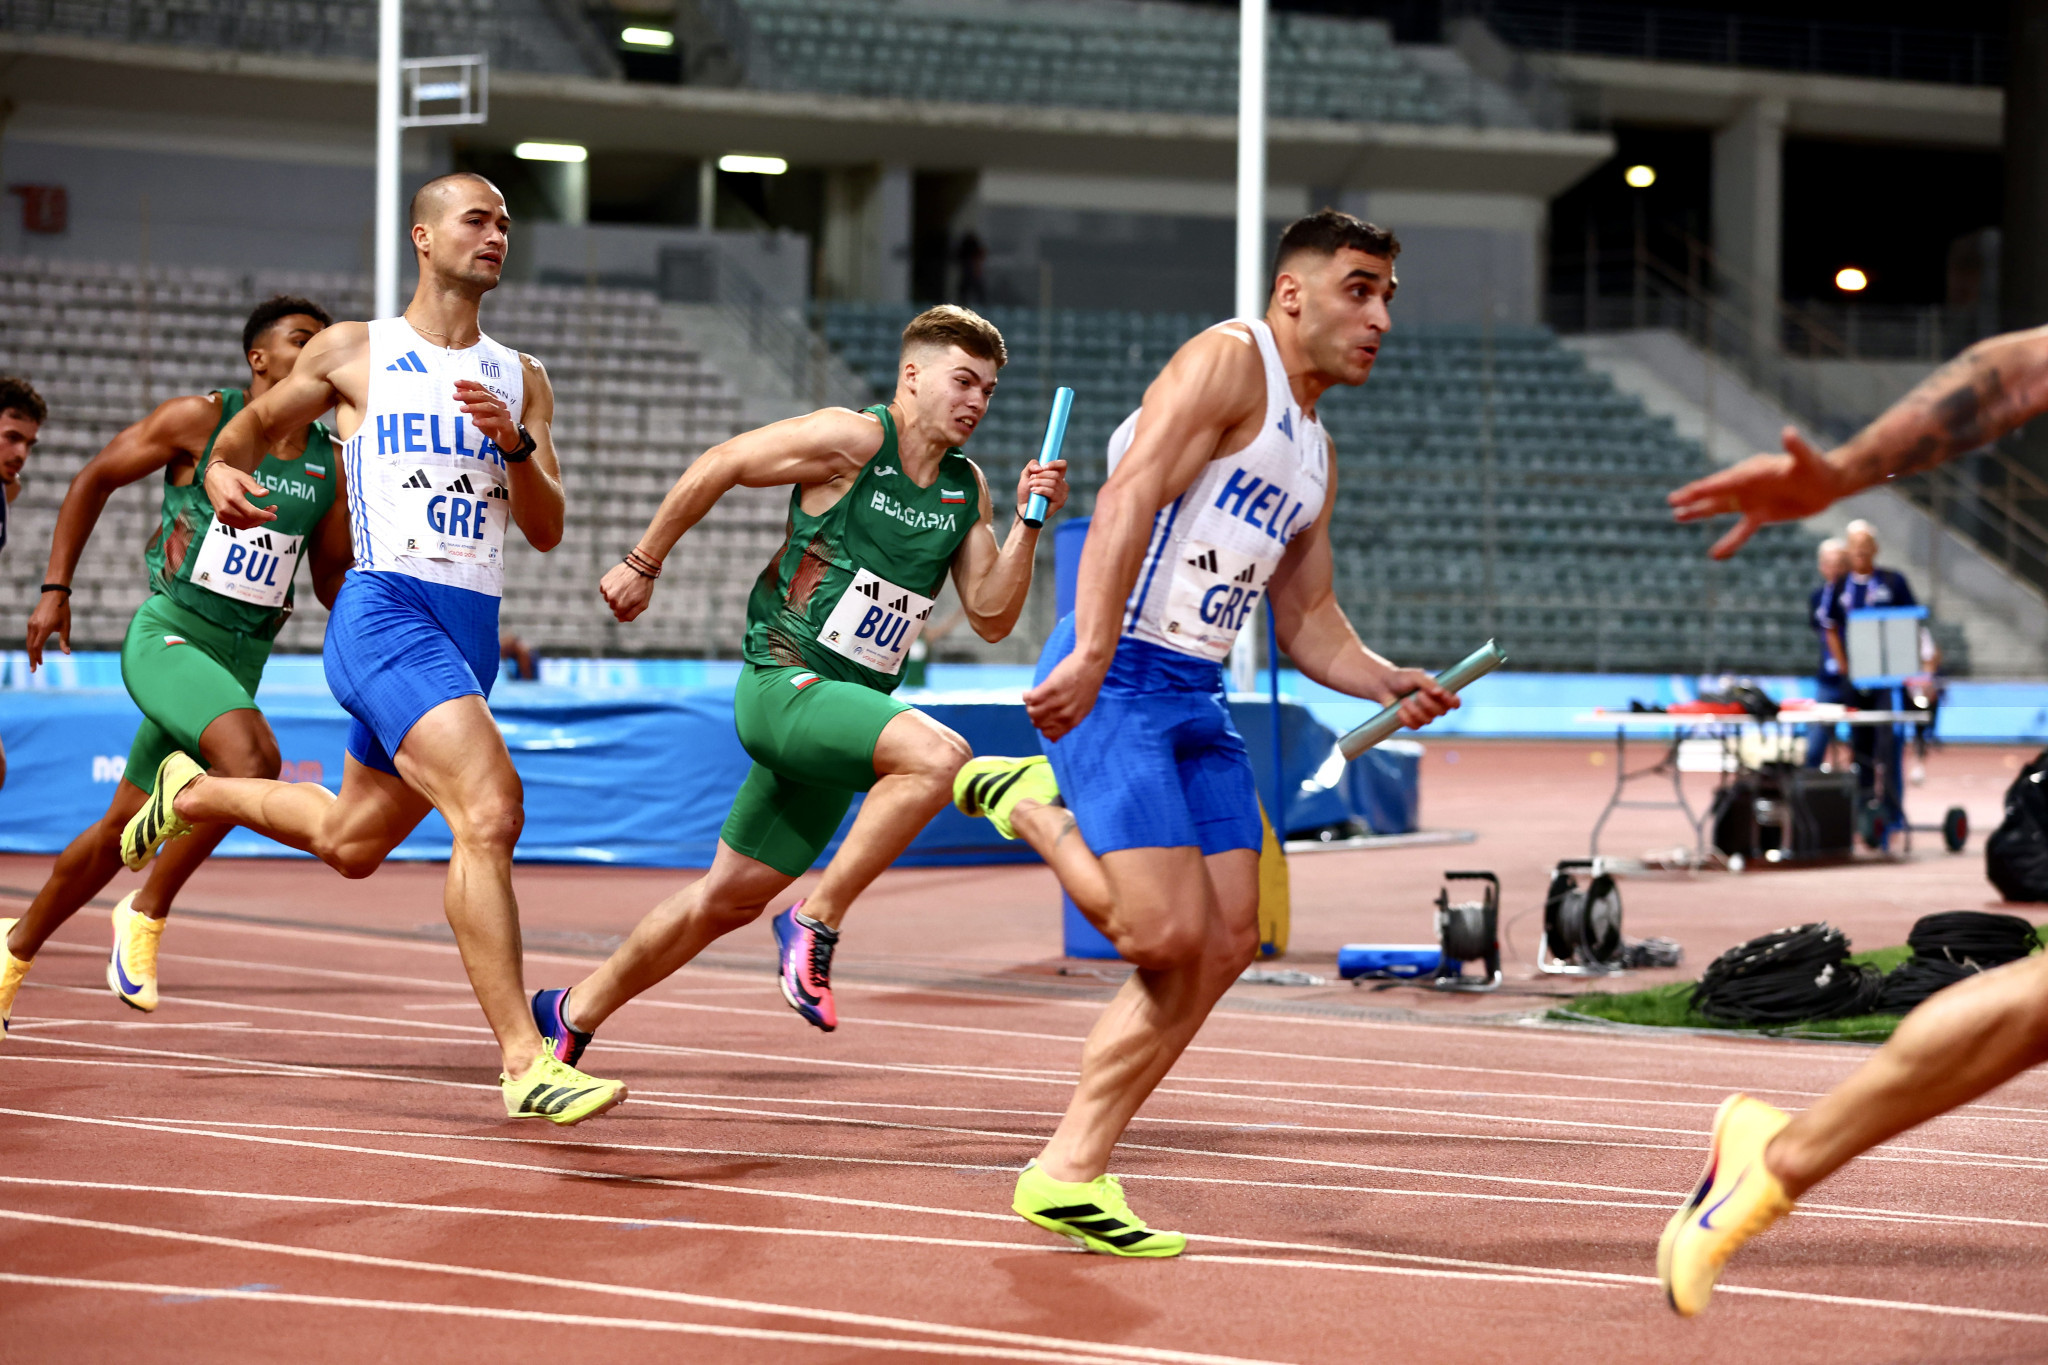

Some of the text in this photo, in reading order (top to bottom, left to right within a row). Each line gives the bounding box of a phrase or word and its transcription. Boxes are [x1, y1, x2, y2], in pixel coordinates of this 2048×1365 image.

[377, 413, 506, 471] HELLA
[427, 495, 489, 541] GRE
[870, 490, 957, 532] BULGARIA
[1214, 467, 1312, 546] HELL
[222, 543, 280, 587] BUL
[854, 605, 911, 654] BUL
[1200, 584, 1258, 631] GRE
